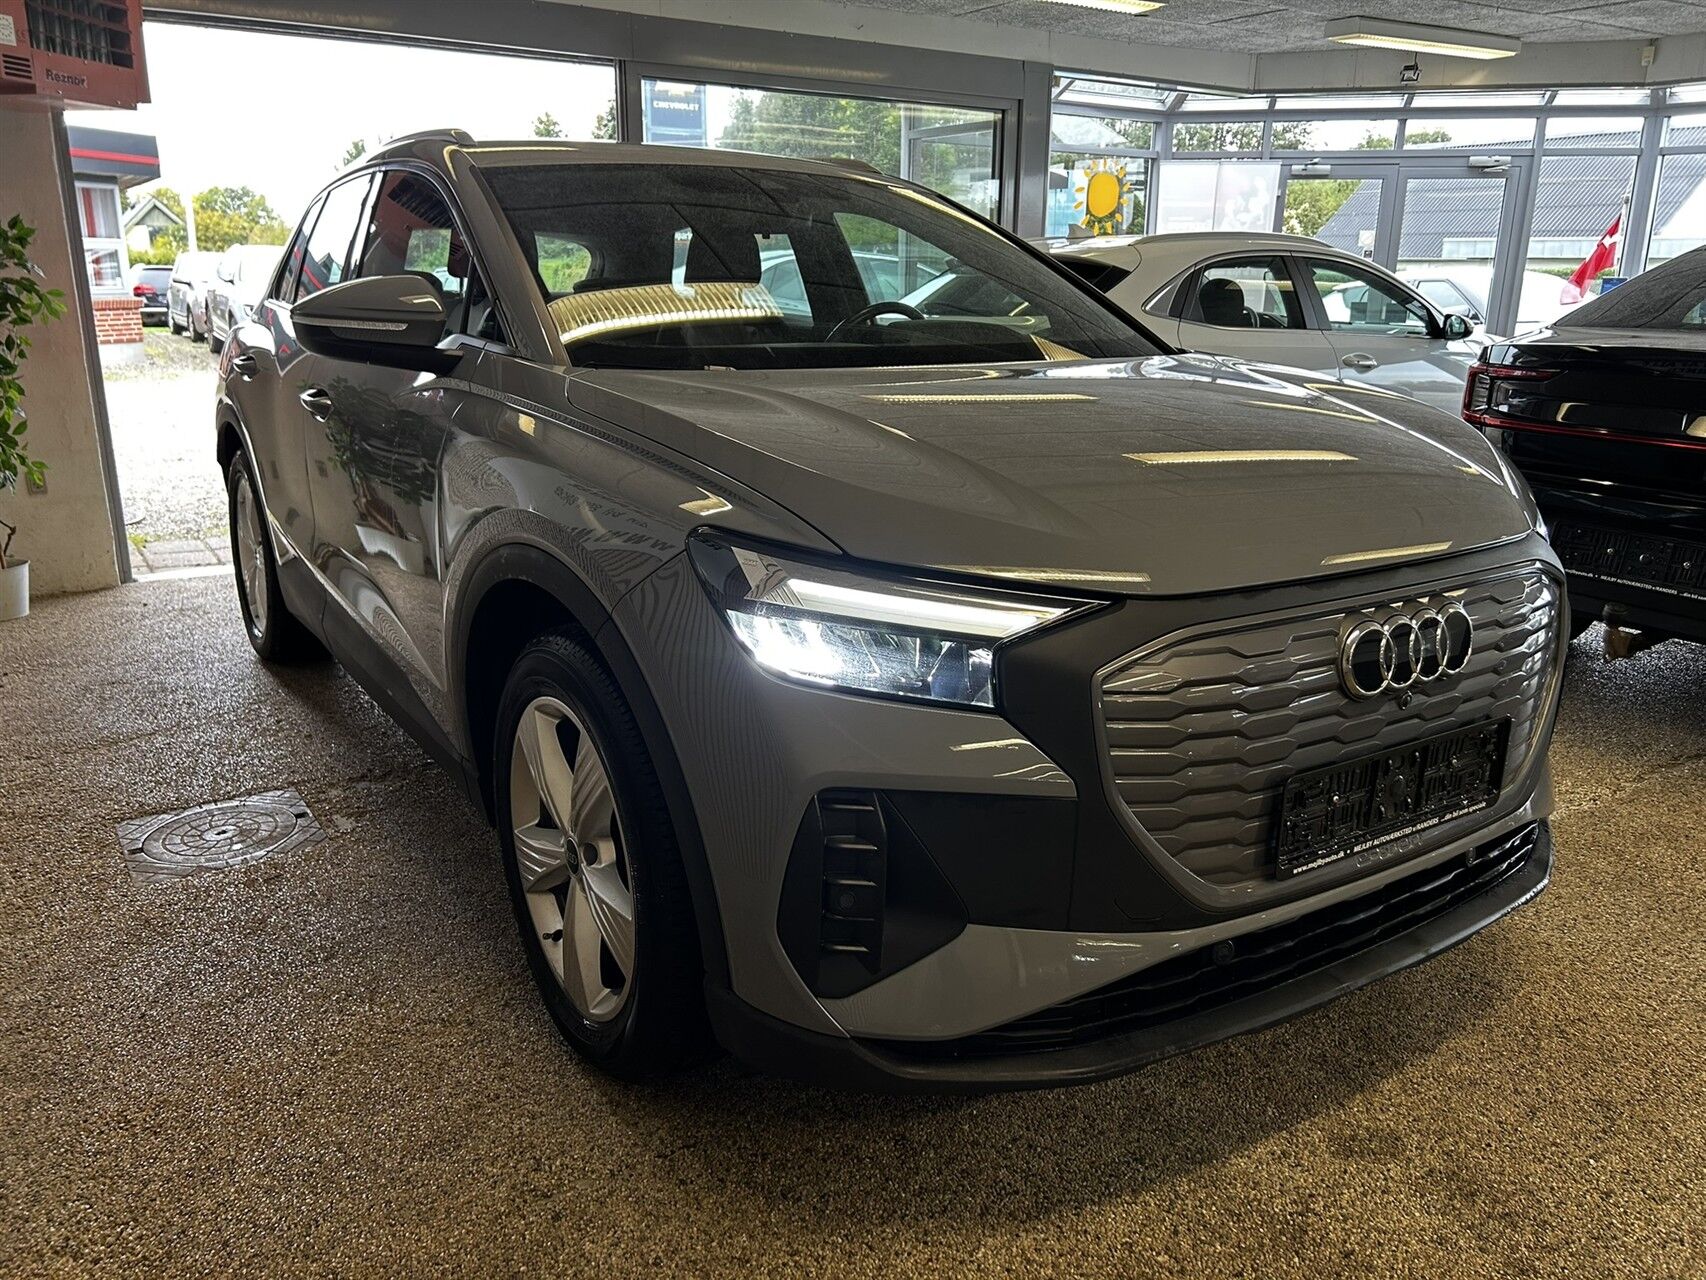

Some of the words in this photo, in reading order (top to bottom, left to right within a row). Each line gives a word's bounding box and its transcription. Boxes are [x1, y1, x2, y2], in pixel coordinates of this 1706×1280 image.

[46, 69, 86, 86] Reznor
[652, 100, 700, 112] CHEVROLET
[1353, 840, 1374, 853] MEJLBY
